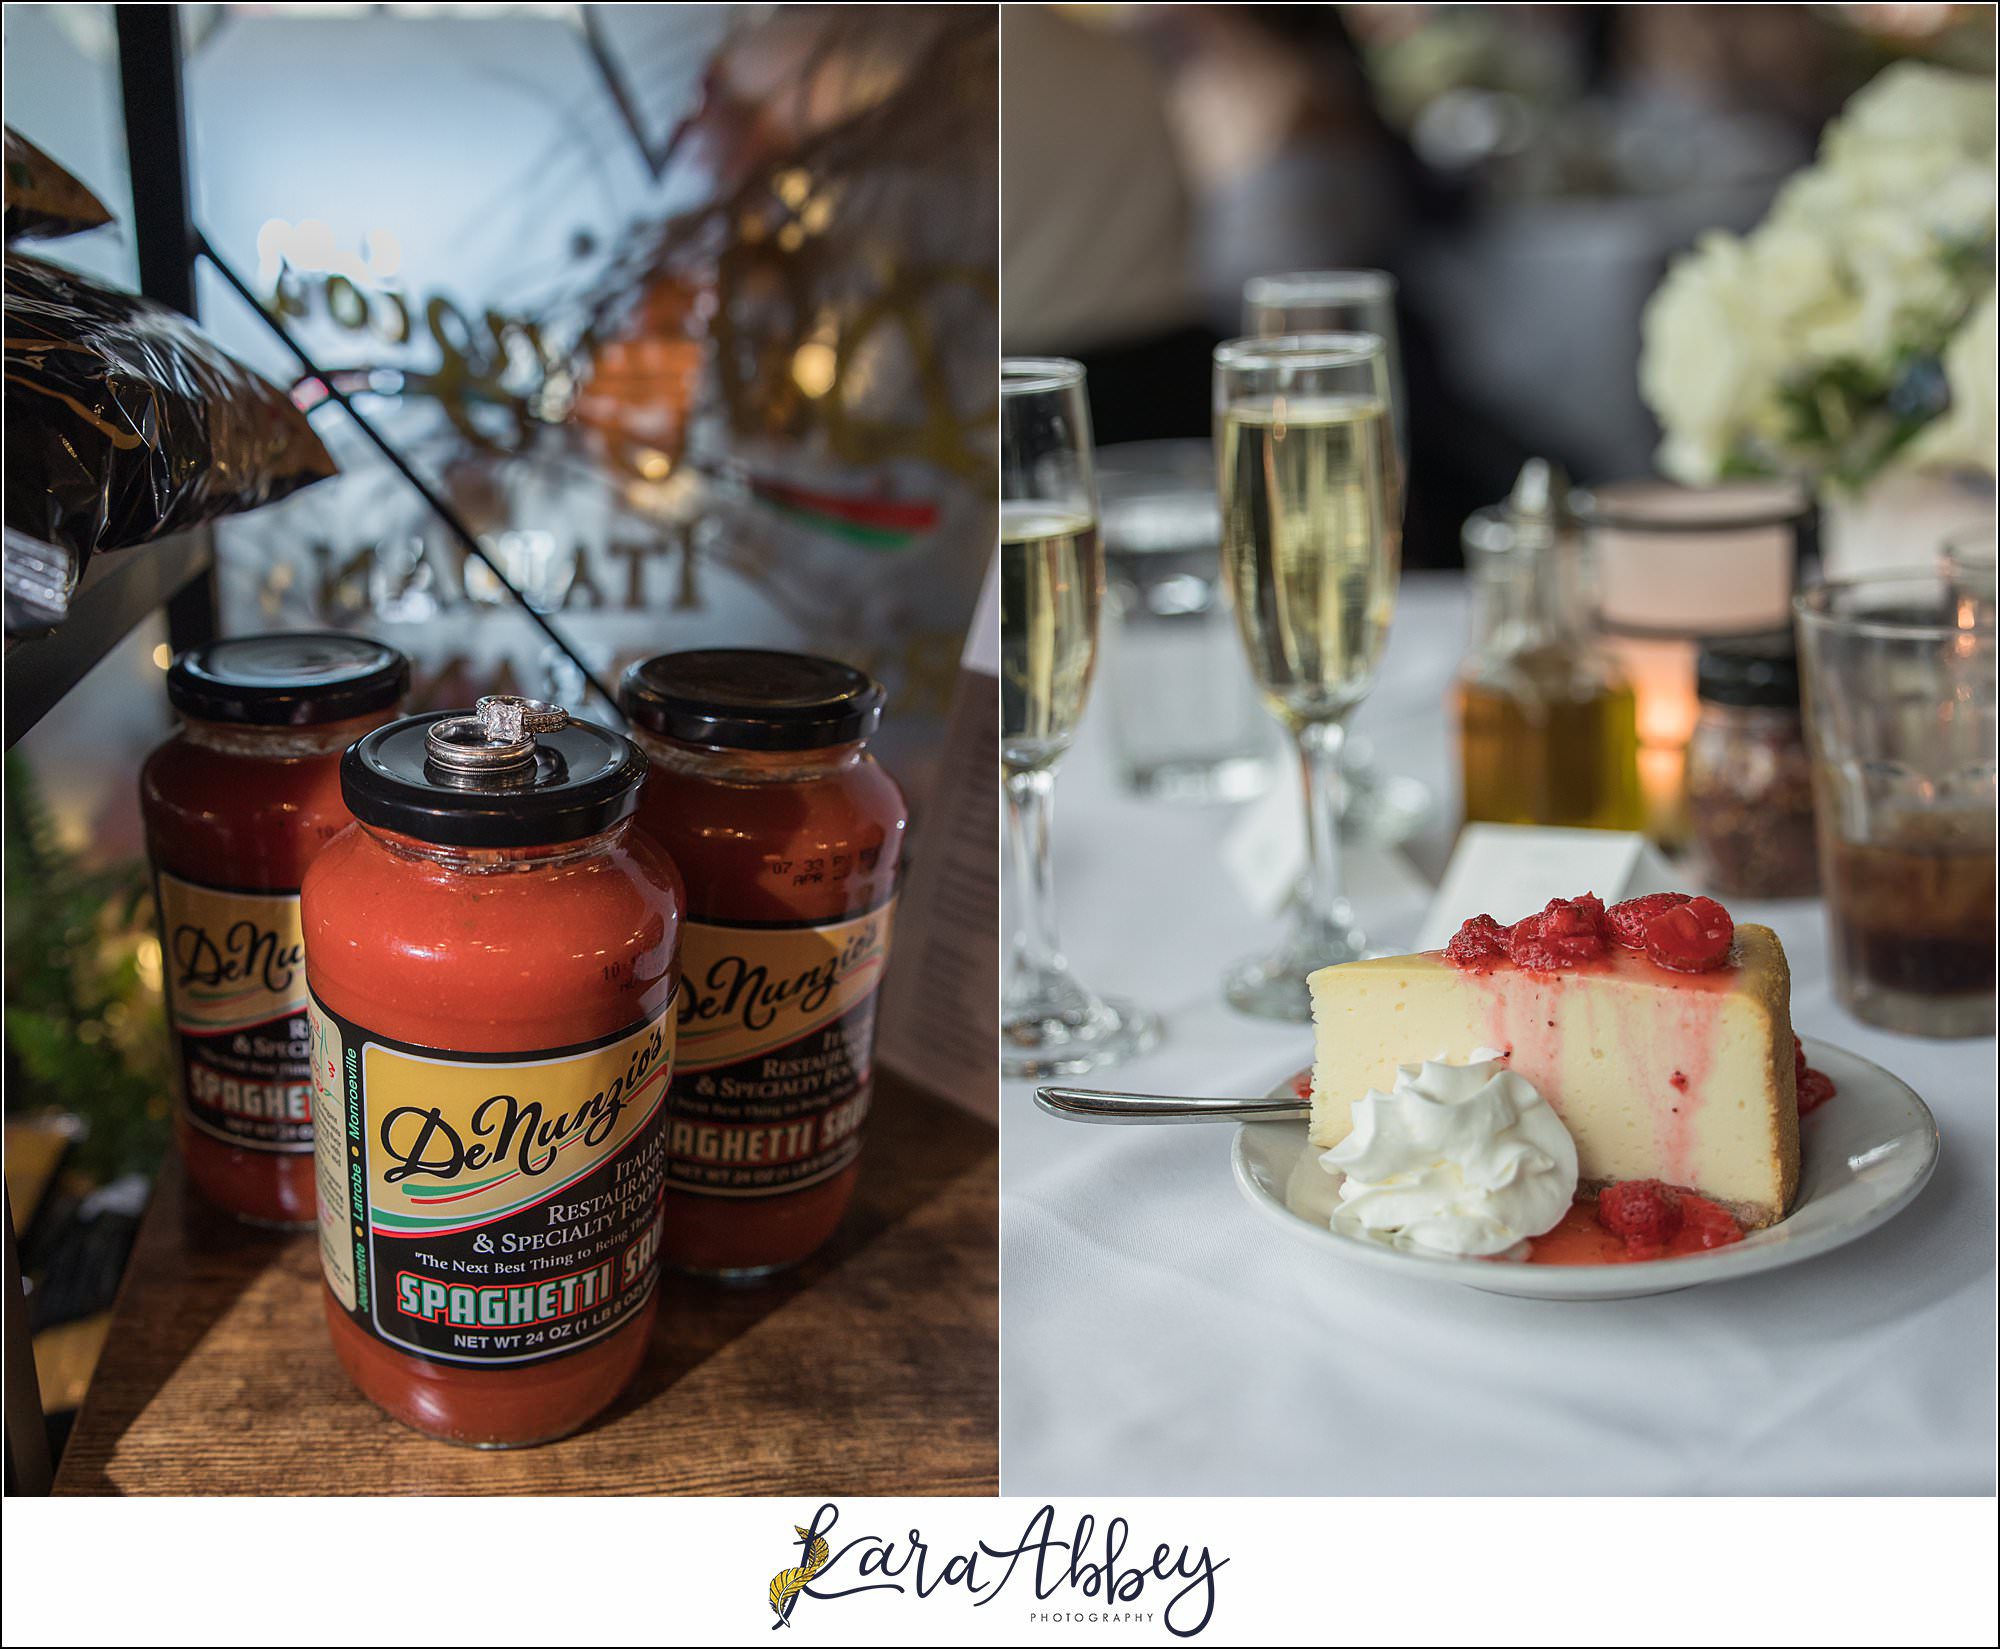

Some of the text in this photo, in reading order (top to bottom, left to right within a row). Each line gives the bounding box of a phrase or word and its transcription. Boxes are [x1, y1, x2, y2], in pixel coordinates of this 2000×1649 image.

[173, 920, 305, 993] DeNu
[678, 922, 878, 1031] eNunzio's
[348, 1047, 361, 1141] Monroeville
[380, 1026, 665, 1184] DeNunzio's
[666, 1118, 814, 1163] AGHETTI
[351, 1163, 364, 1222] Latrobe
[452, 1260, 489, 1274] Next
[494, 1261, 526, 1274] Best
[530, 1253, 574, 1272] Thing
[578, 1248, 592, 1260] to
[595, 1229, 629, 1254] Being
[473, 1233, 495, 1254] &
[501, 1210, 617, 1253] SPECIALTY
[357, 1242, 369, 1313] Jeannette
[398, 1259, 613, 1327] SPAGHETTI
[453, 1333, 490, 1349] NET
[494, 1335, 522, 1348] WT
[525, 1330, 544, 1346] 24
[549, 1324, 572, 1340] OZ
[575, 1317, 588, 1335] (1
[592, 1306, 612, 1325] LB
